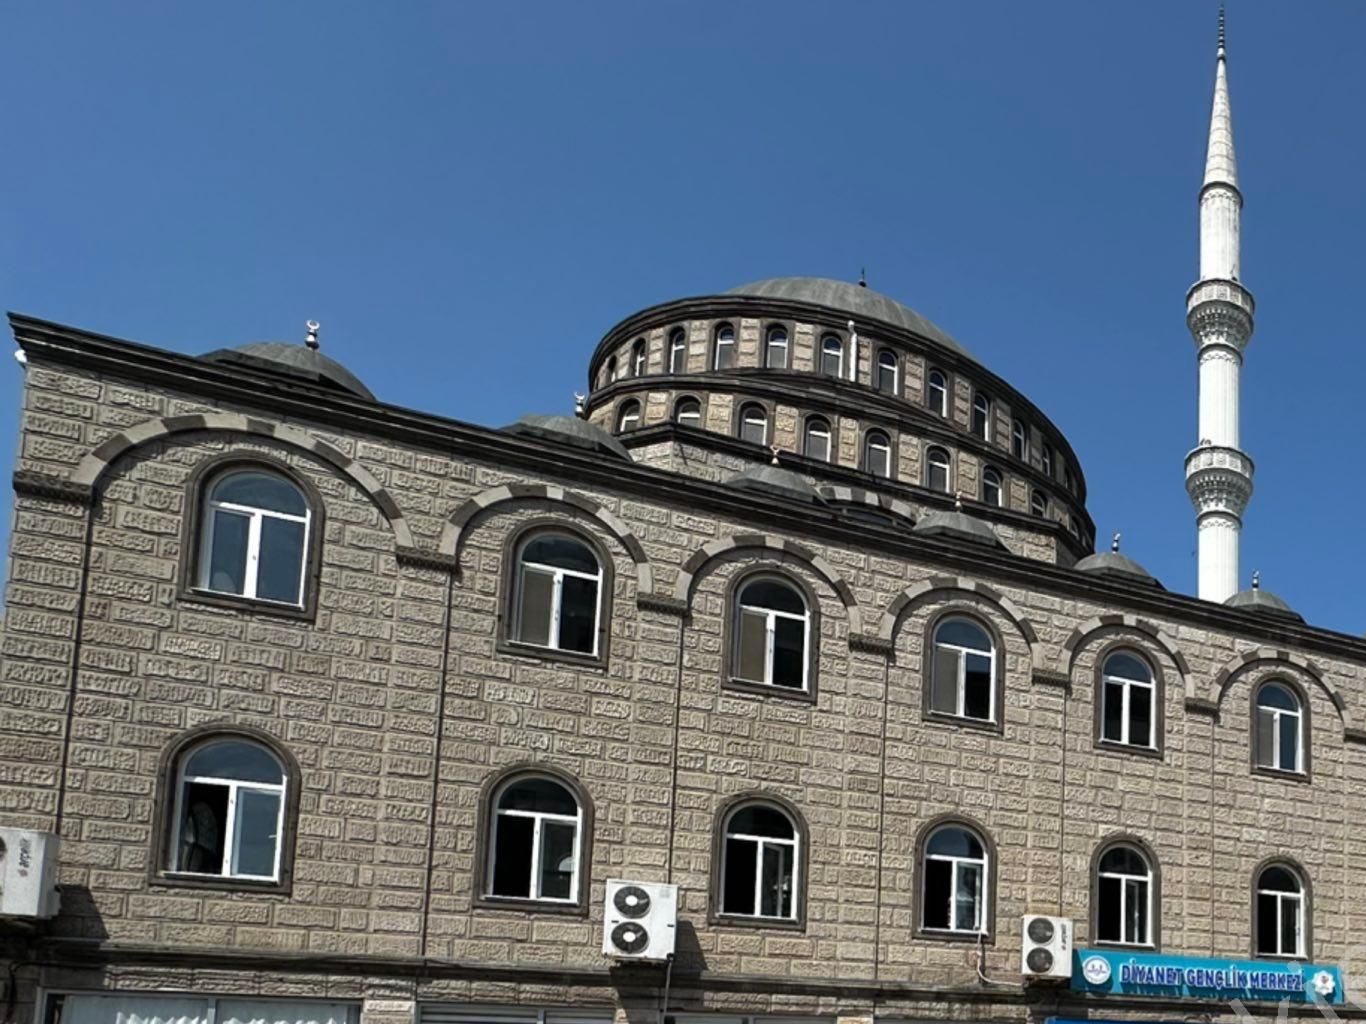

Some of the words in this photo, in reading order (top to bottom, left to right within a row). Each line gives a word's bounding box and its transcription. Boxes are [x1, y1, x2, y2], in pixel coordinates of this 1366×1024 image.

[1119, 957, 1184, 986] DİYANET
[1184, 963, 1249, 990] GENÇLİK
[1249, 967, 1304, 992] MERKEZİ
